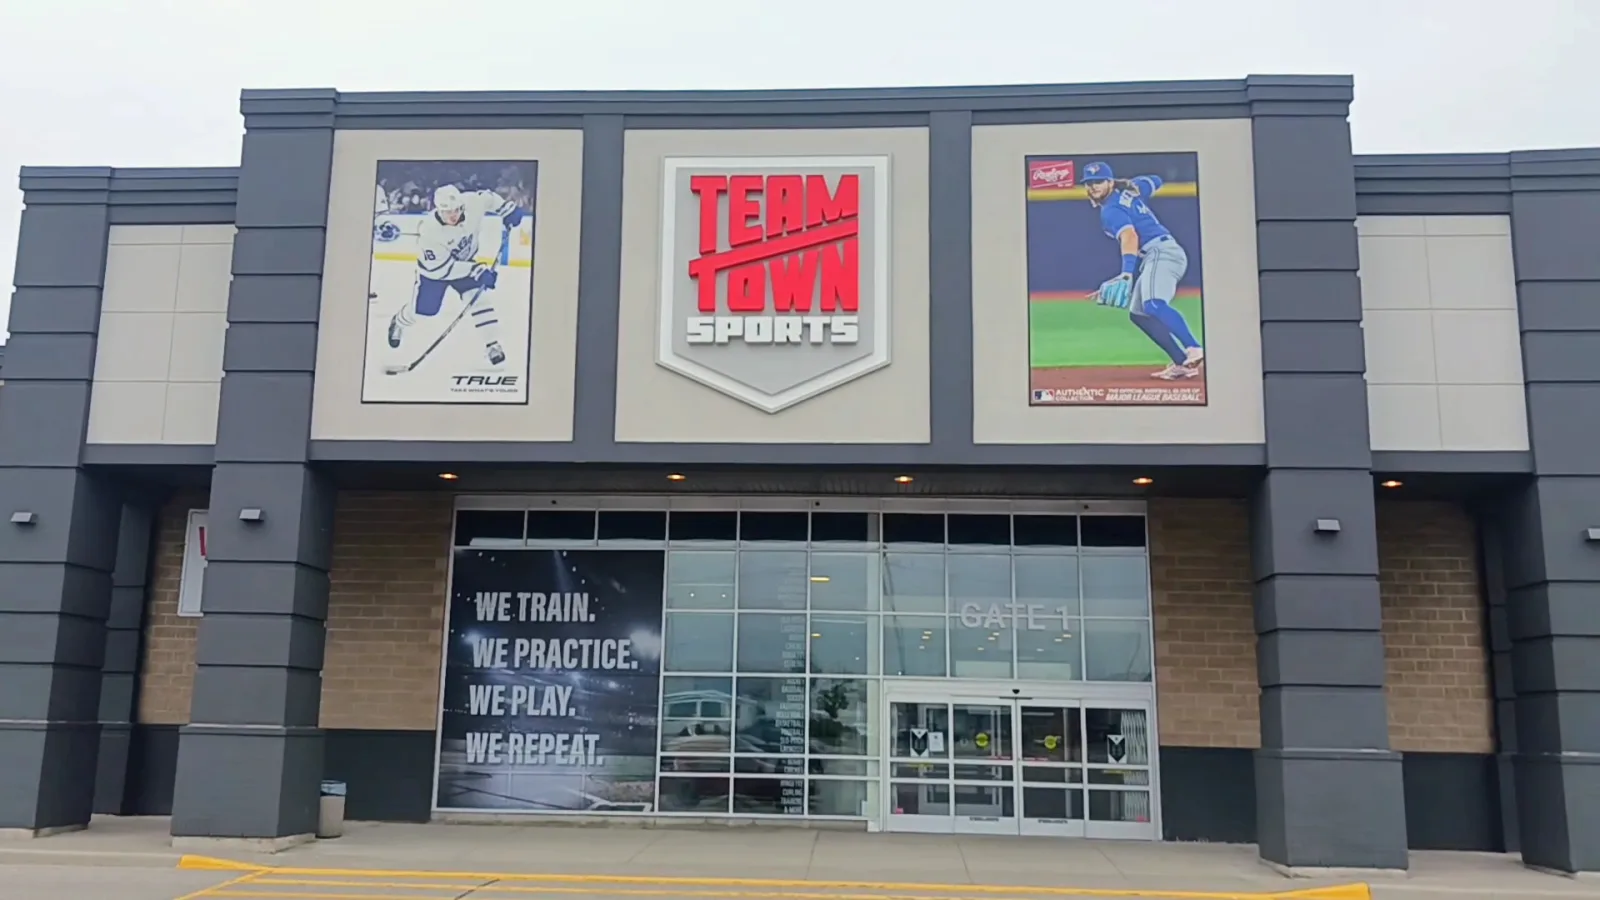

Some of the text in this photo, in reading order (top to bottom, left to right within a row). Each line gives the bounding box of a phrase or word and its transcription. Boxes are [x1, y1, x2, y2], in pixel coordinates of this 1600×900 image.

[690, 174, 859, 256] TEAM
[689, 221, 859, 313] TOWN
[686, 316, 859, 345] SPORTS
[451, 376, 519, 386] TRUE
[1055, 387, 1105, 396] AUTHENTIC
[1105, 393, 1202, 401] MAJOR LEAGUE BASEBALL
[475, 591, 596, 622] WE TRAIN.
[961, 602, 1069, 631] GATE 1
[472, 638, 638, 670] WE PRACTICE.
[469, 685, 576, 717] WE PLAY.
[466, 732, 605, 765] WE REPEAT.
